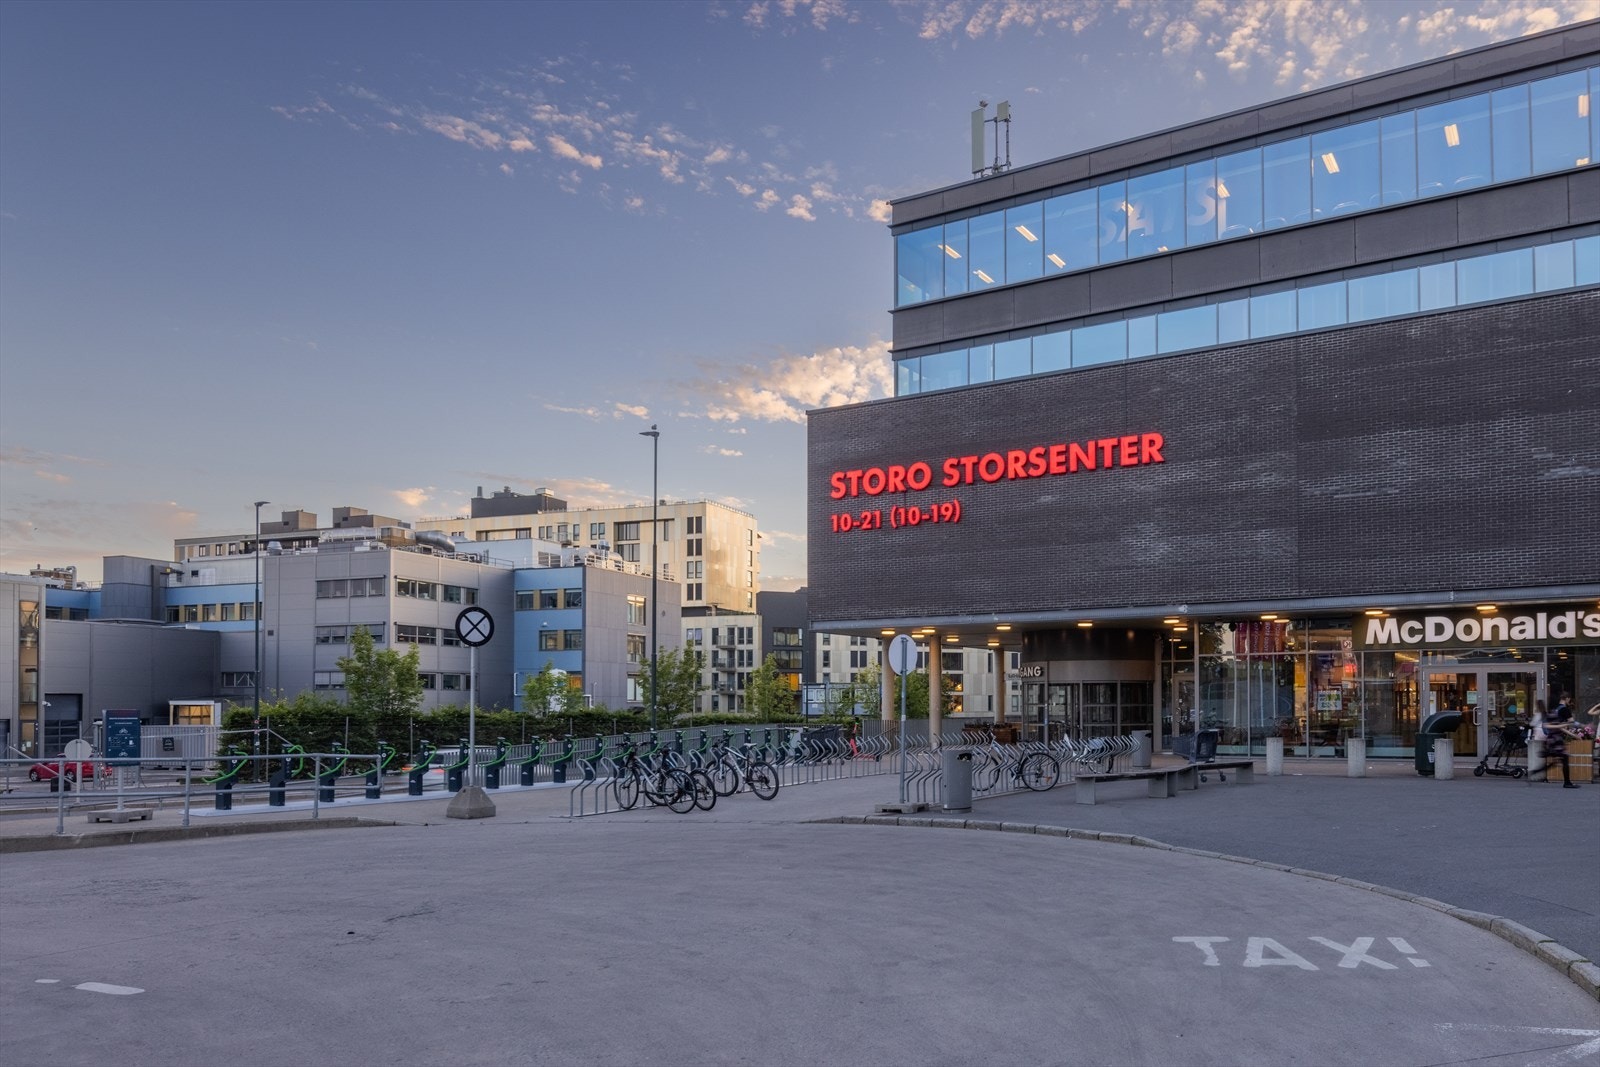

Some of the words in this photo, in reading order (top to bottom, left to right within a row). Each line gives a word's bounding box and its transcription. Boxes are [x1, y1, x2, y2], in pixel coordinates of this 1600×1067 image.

[829, 461, 933, 499] STORO
[941, 431, 1165, 487] STORSENTER
[830, 509, 882, 533] 10-21
[889, 498, 961, 529] (10-19)
[1365, 611, 1600, 645] McDonald's
